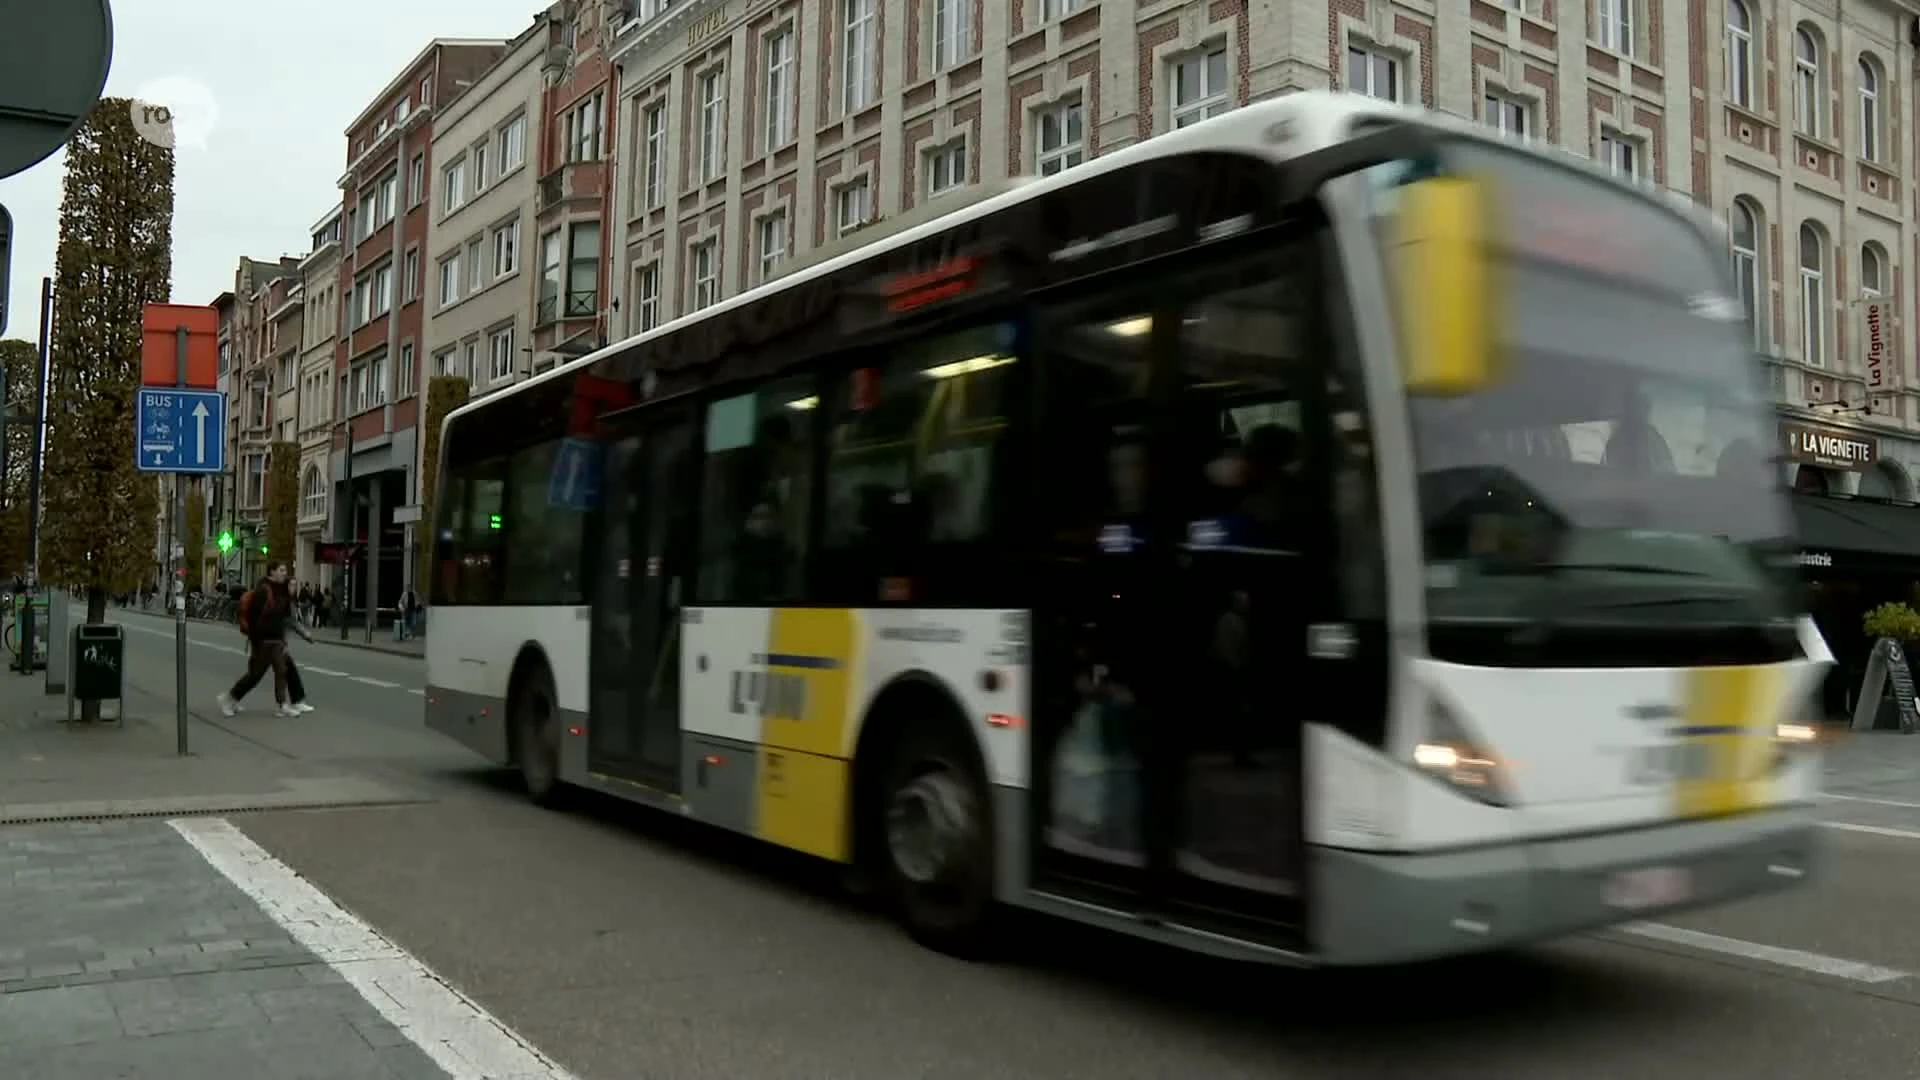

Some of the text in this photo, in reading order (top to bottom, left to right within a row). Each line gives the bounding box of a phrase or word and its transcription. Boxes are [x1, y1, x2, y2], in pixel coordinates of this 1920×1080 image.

[687, 4, 728, 46] HOTEL
[1867, 304, 1884, 387] La Vignette
[146, 395, 172, 407] BUS
[1802, 432, 1817, 453] LA
[1818, 435, 1869, 462] VIGNETTE
